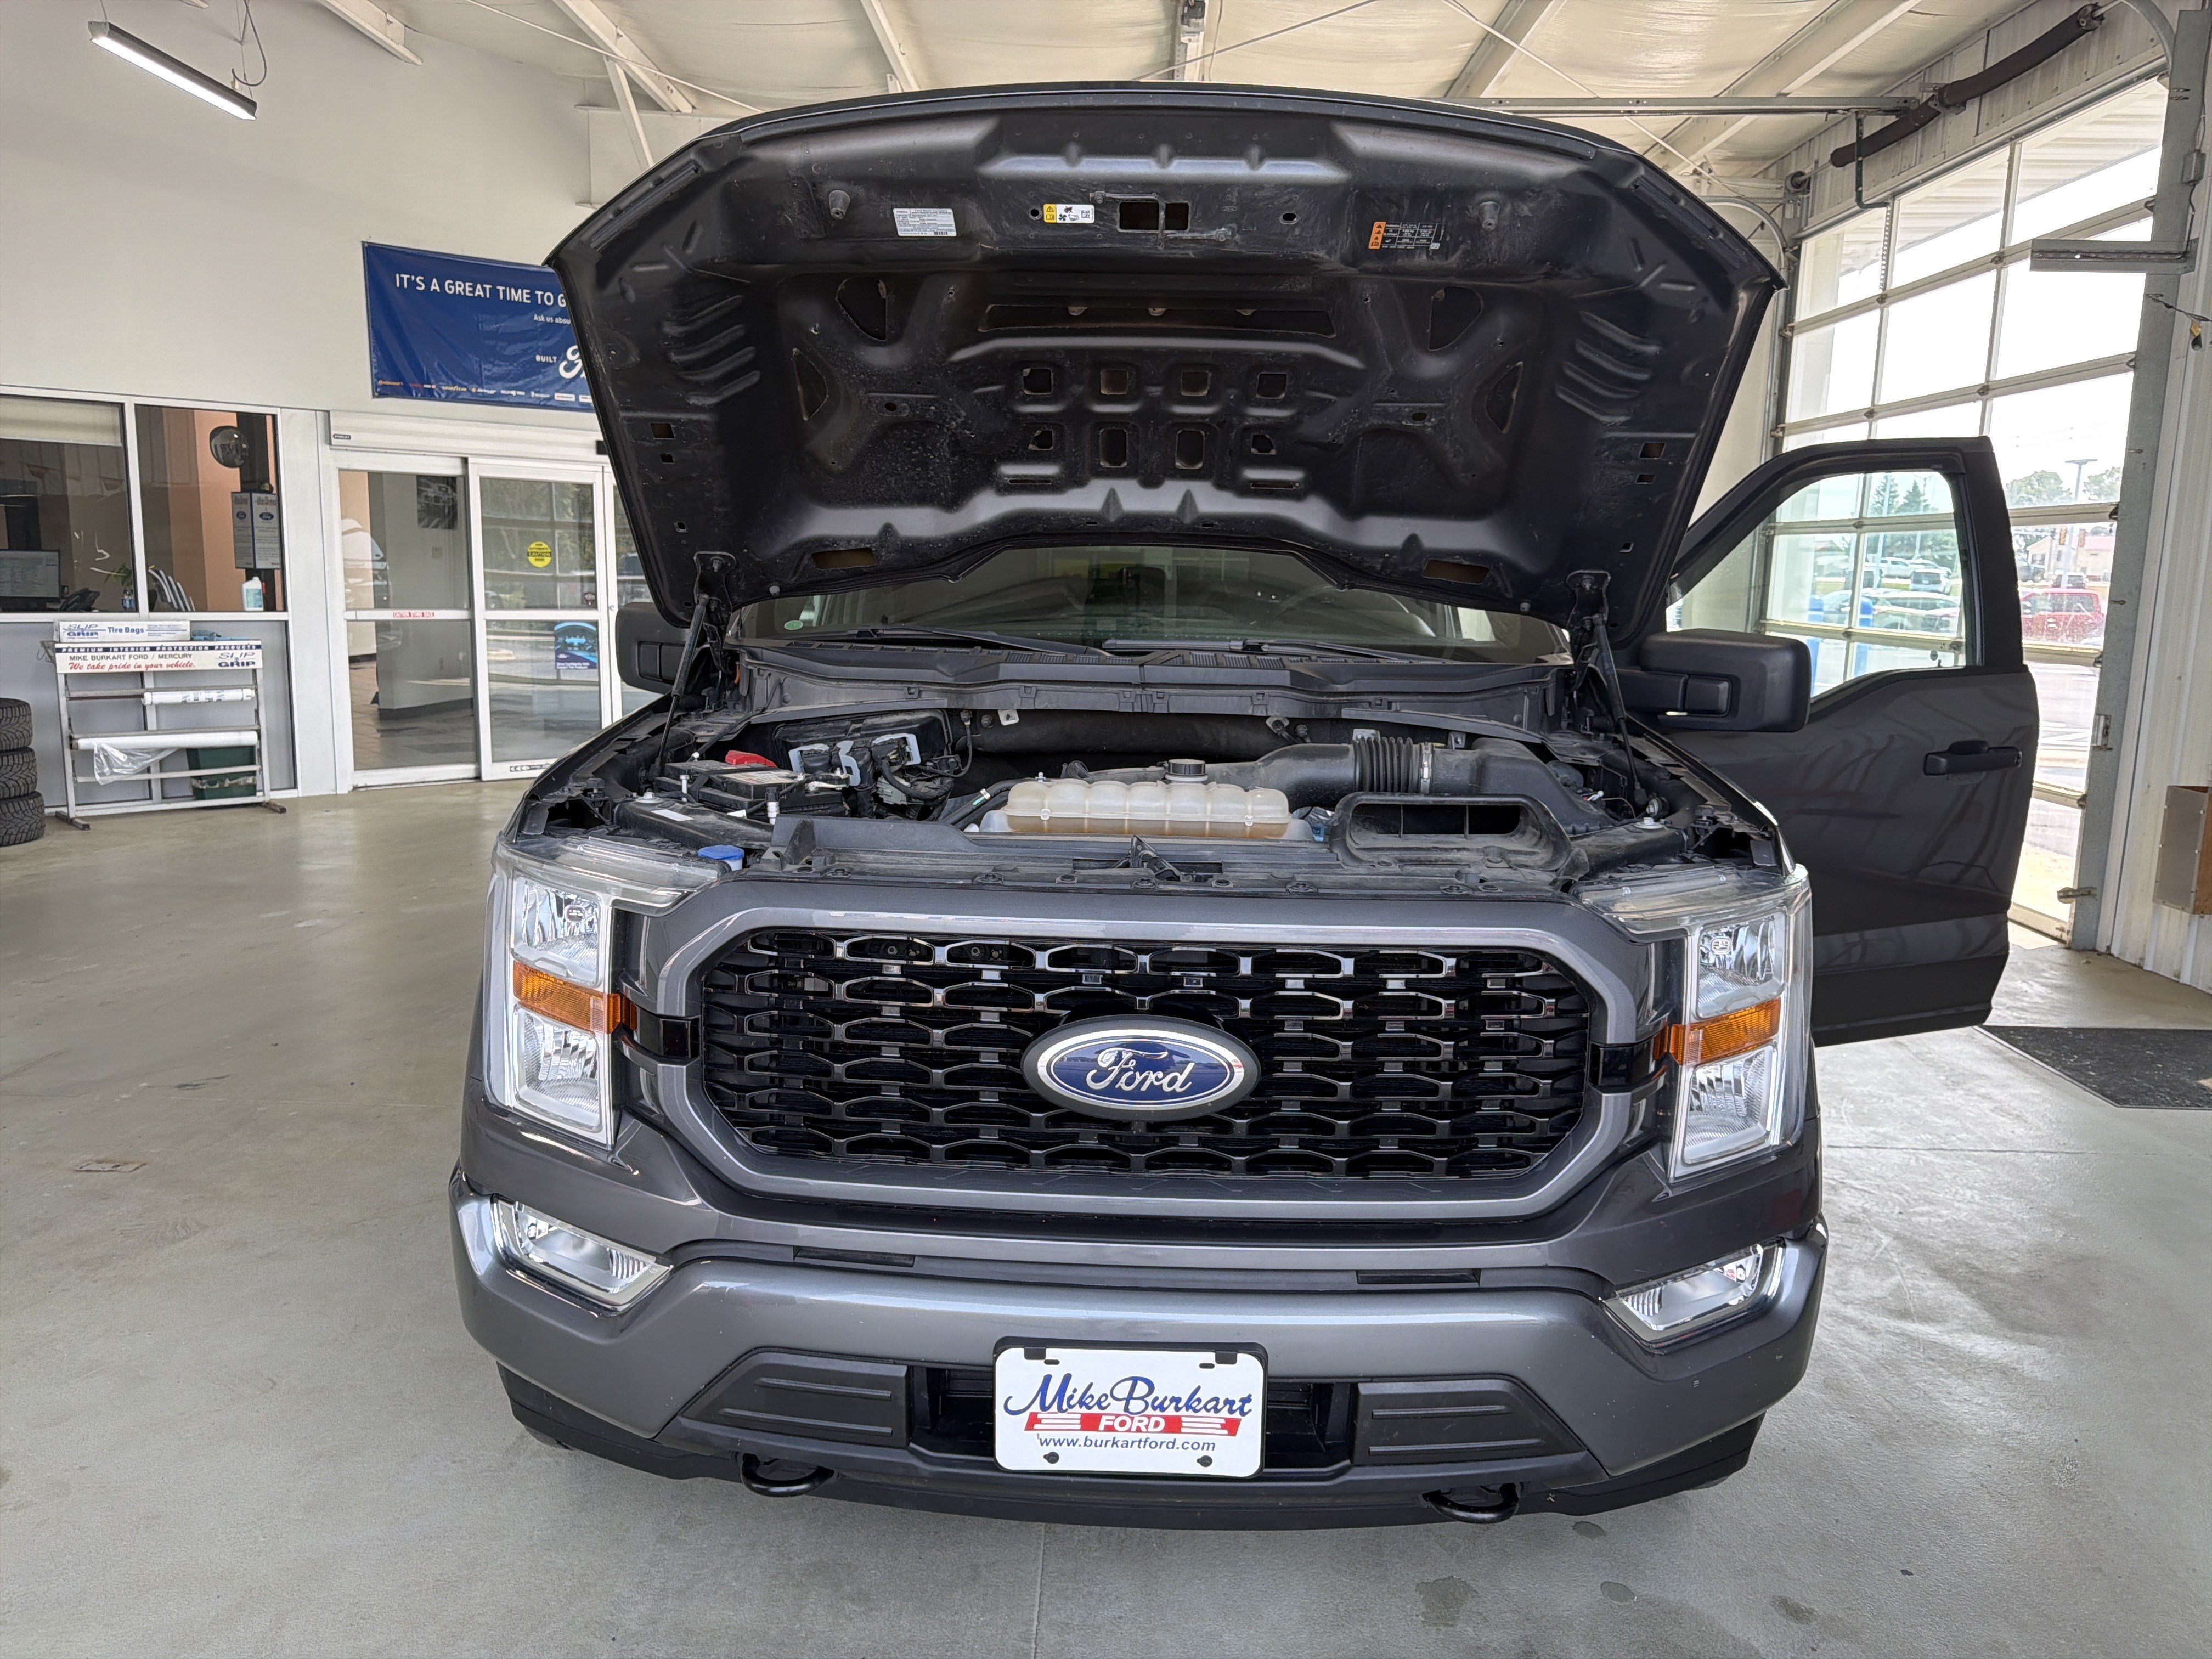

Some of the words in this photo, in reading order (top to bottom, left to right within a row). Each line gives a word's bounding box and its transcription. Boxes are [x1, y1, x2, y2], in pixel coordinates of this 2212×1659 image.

[396, 273, 425, 291] IT'S
[430, 278, 441, 292] A
[444, 280, 492, 298] GREAT
[496, 285, 531, 303] TIME
[535, 290, 554, 306] TO
[557, 293, 567, 308] G
[533, 313, 545, 322] Ask
[555, 316, 571, 325] abou
[535, 354, 557, 363] BUILT
[125, 627, 144, 635] Bags
[69, 662, 84, 670] We
[87, 662, 106, 670] take
[108, 662, 132, 672] pride
[144, 663, 163, 672] your
[1086, 1047, 1195, 1092] Ford
[1003, 1373, 1112, 1416] Mike
[1109, 1376, 1253, 1418] Burkart
[1098, 1415, 1165, 1432] FORD
[1038, 1435, 1216, 1452] www.burkartford.com
